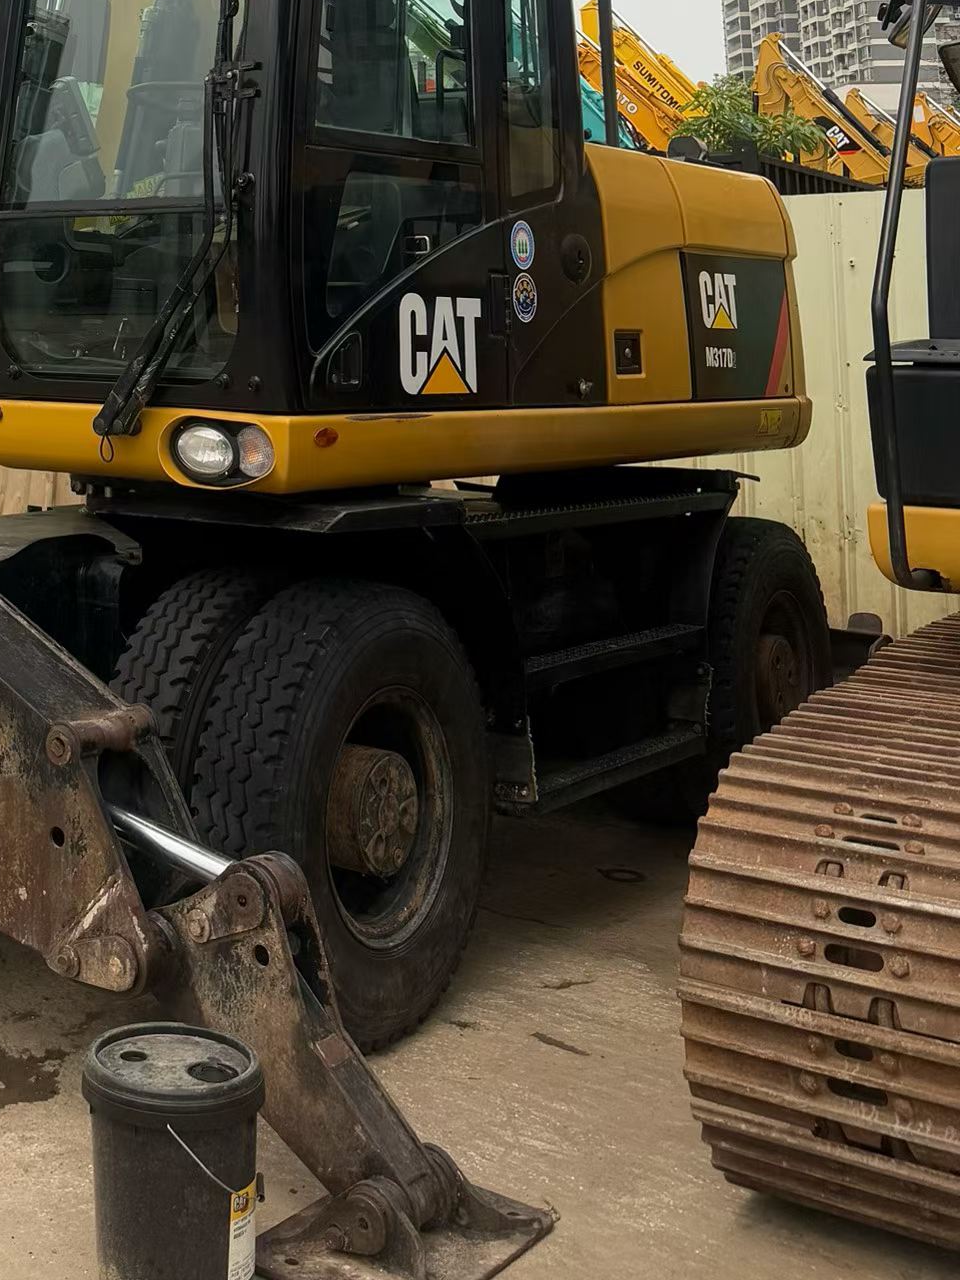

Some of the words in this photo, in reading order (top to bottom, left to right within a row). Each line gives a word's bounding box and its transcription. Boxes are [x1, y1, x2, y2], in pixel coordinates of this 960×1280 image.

[826, 125, 850, 149] CAT
[699, 271, 738, 329] CAT
[399, 292, 482, 395] CAT
